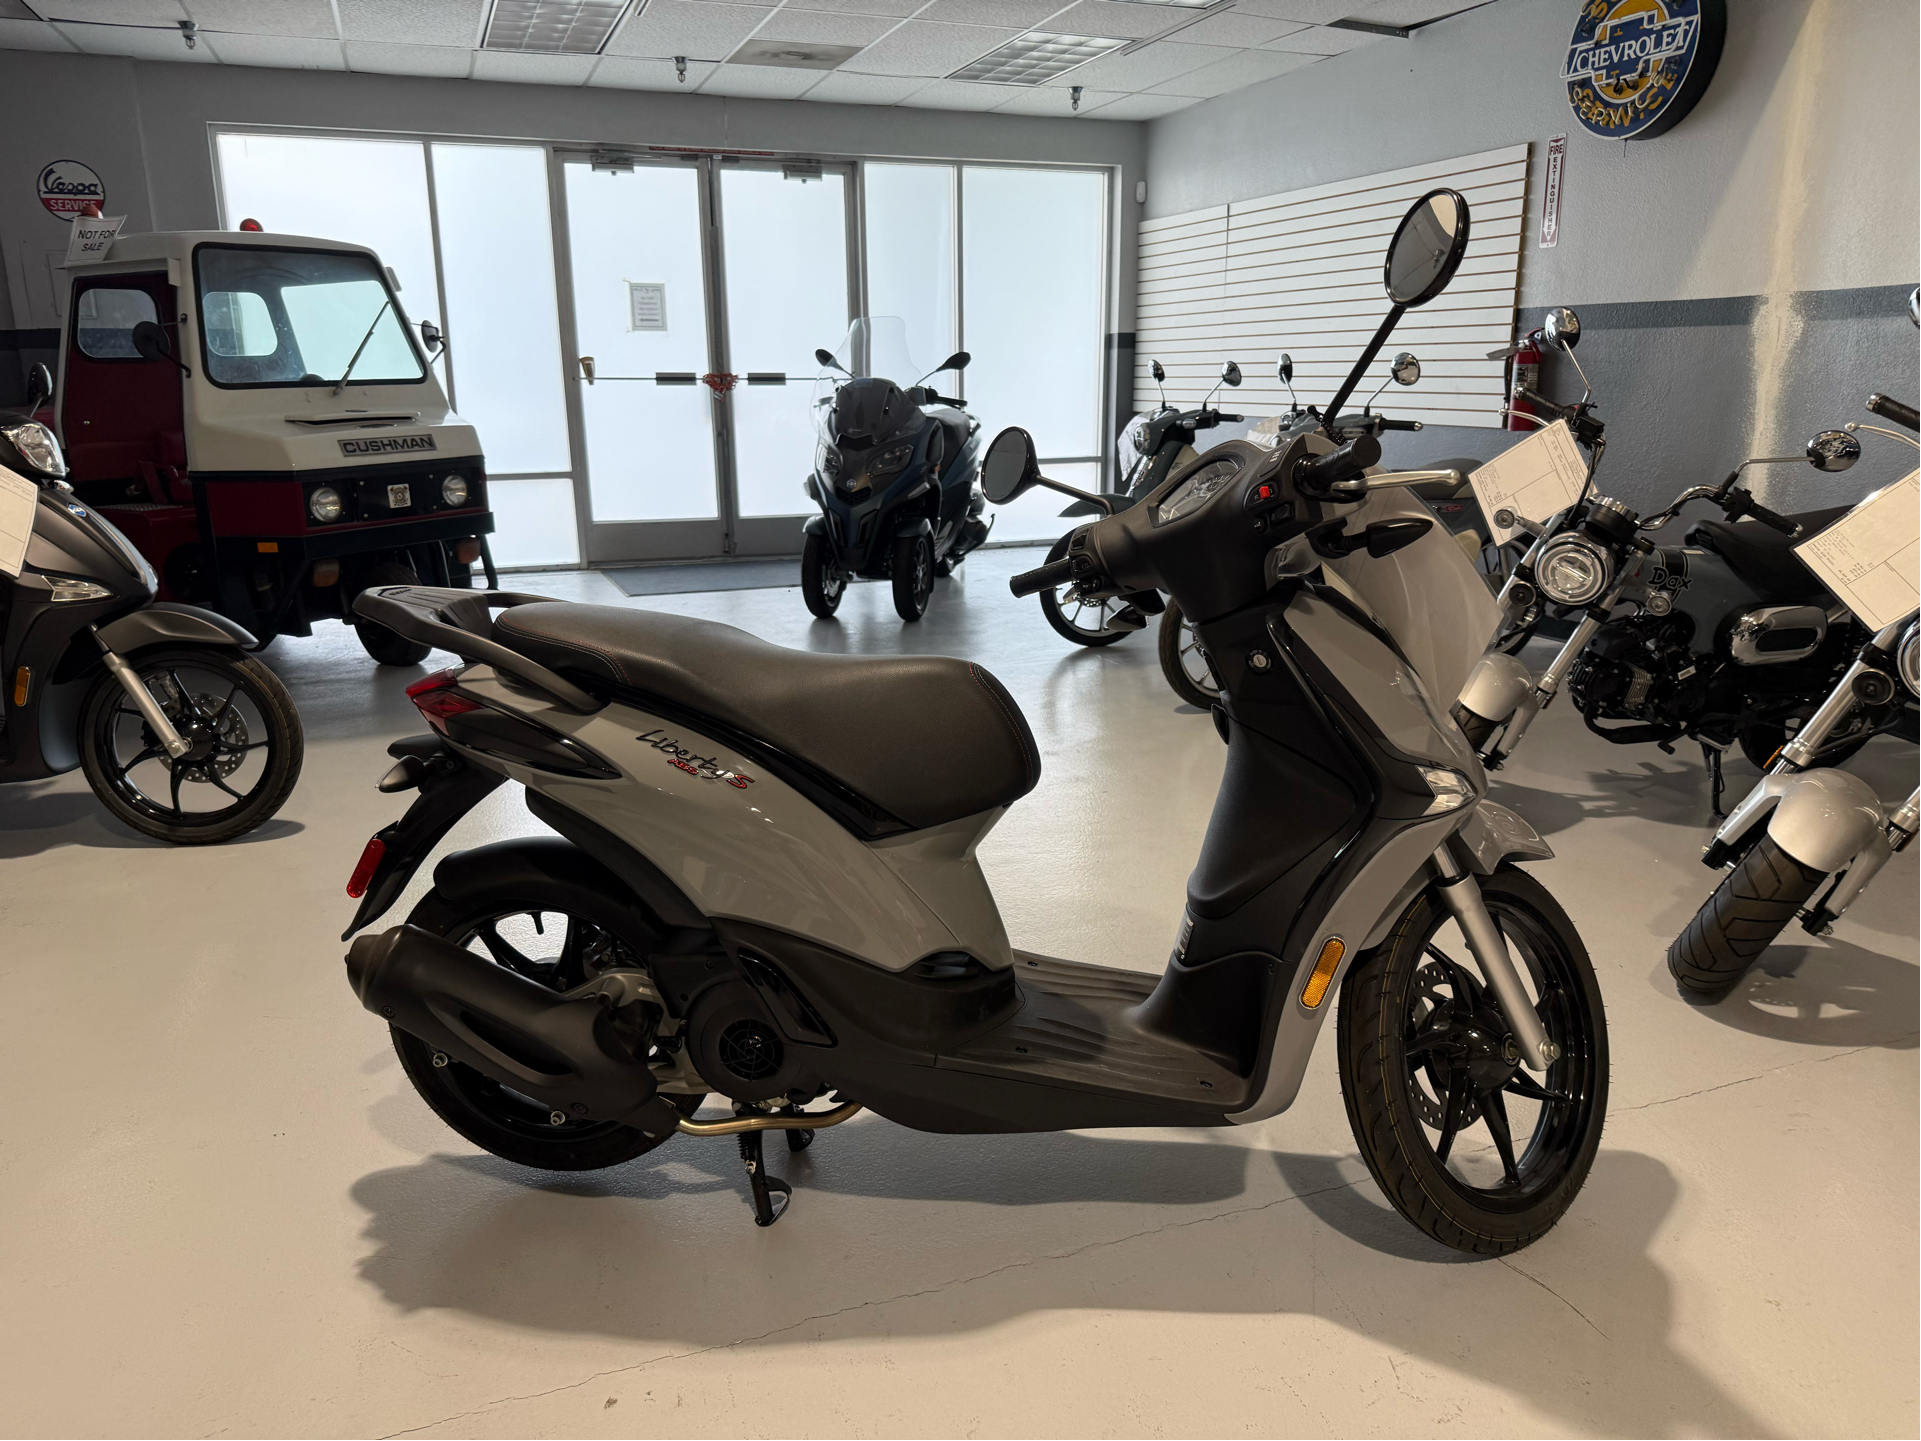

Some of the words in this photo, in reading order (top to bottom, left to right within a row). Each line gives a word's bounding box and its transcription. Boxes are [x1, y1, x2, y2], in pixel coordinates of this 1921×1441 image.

[1577, 25, 1689, 72] CHEVROLET
[1569, 68, 1677, 129] SERVICE
[1549, 144, 1563, 156] FIRE
[43, 167, 101, 196] Vespa
[1546, 156, 1558, 237] EXTINGUISHER
[78, 229, 99, 240] NOT
[98, 229, 117, 239] FOR
[81, 242, 104, 252] SALE
[343, 437, 434, 454] CUSHMAN
[1647, 566, 1693, 591] Dax
[635, 729, 730, 780] Liberty
